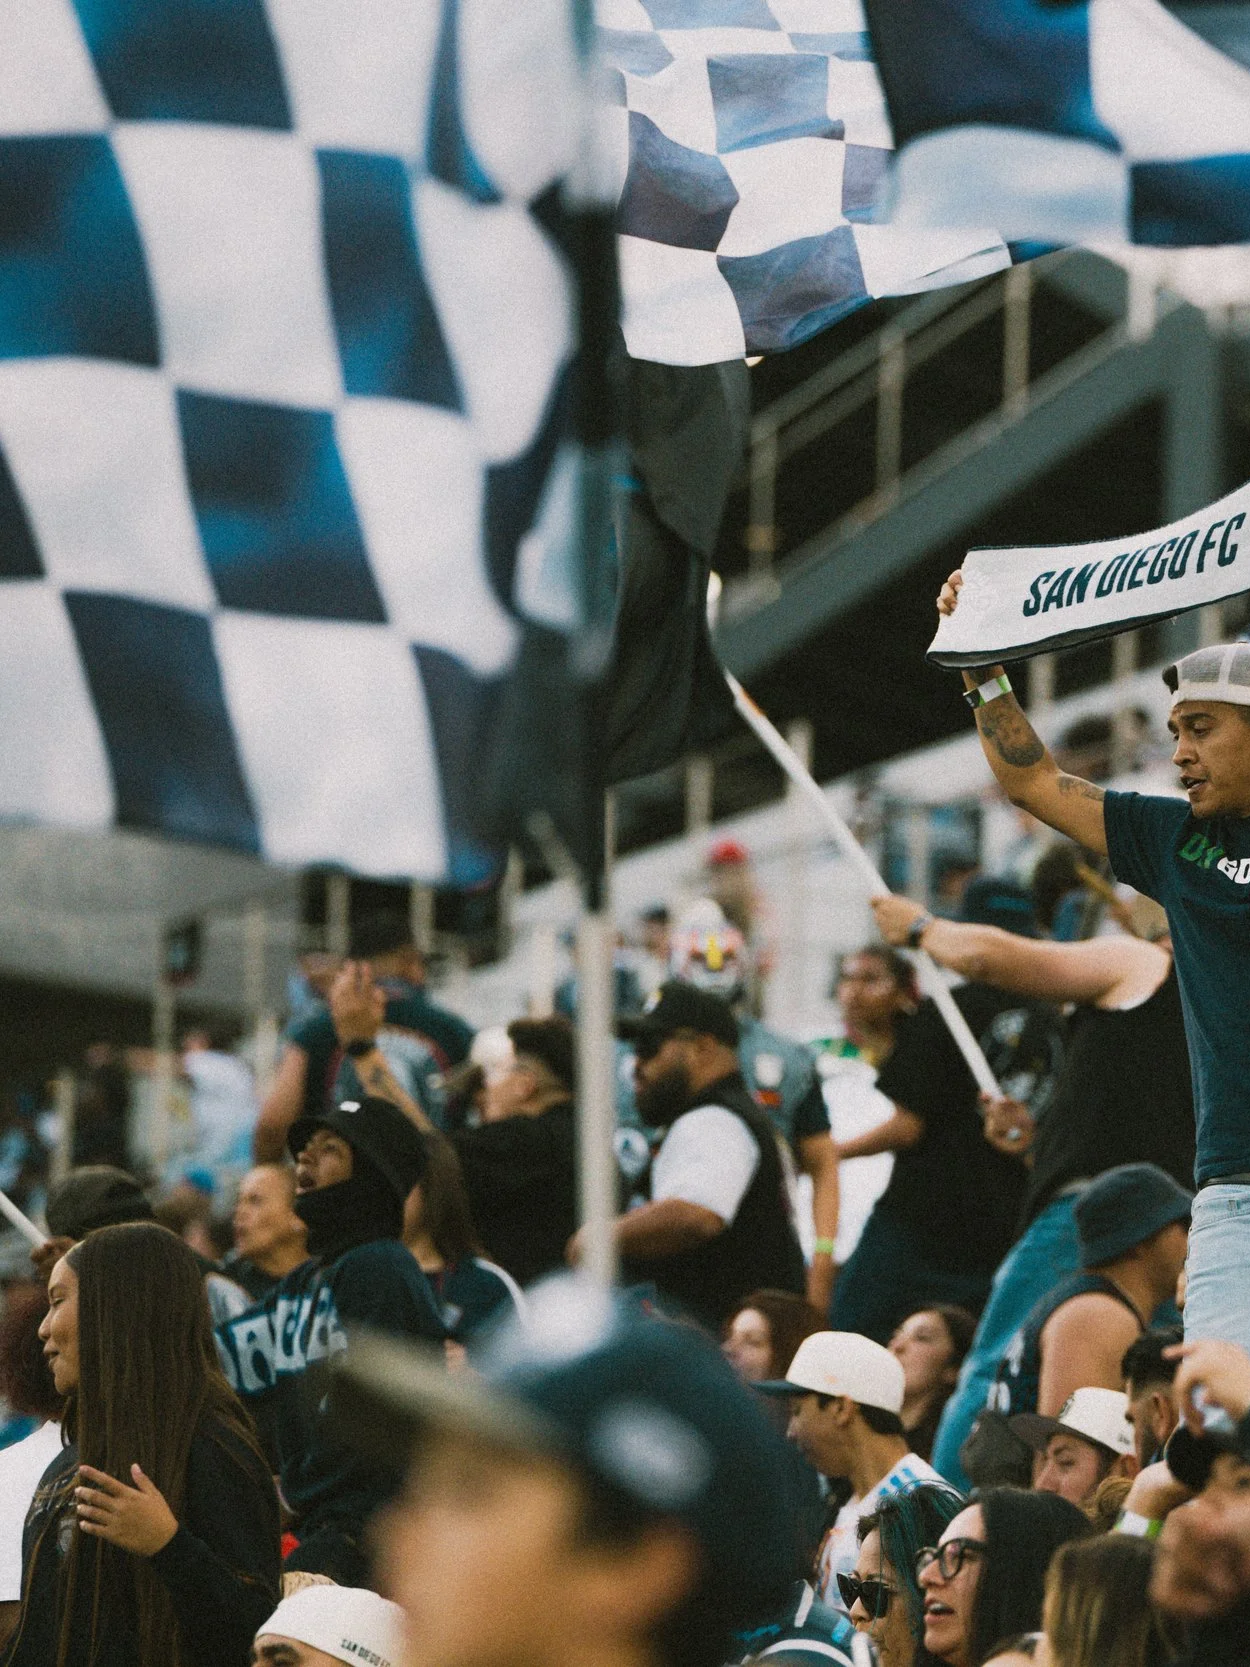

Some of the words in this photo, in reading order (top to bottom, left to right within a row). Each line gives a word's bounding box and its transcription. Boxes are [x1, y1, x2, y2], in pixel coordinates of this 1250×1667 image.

[1022, 560, 1103, 617] SAN
[1094, 529, 1201, 599] DIEGO
[1196, 512, 1247, 574] FC
[341, 1639, 358, 1653] SAN
